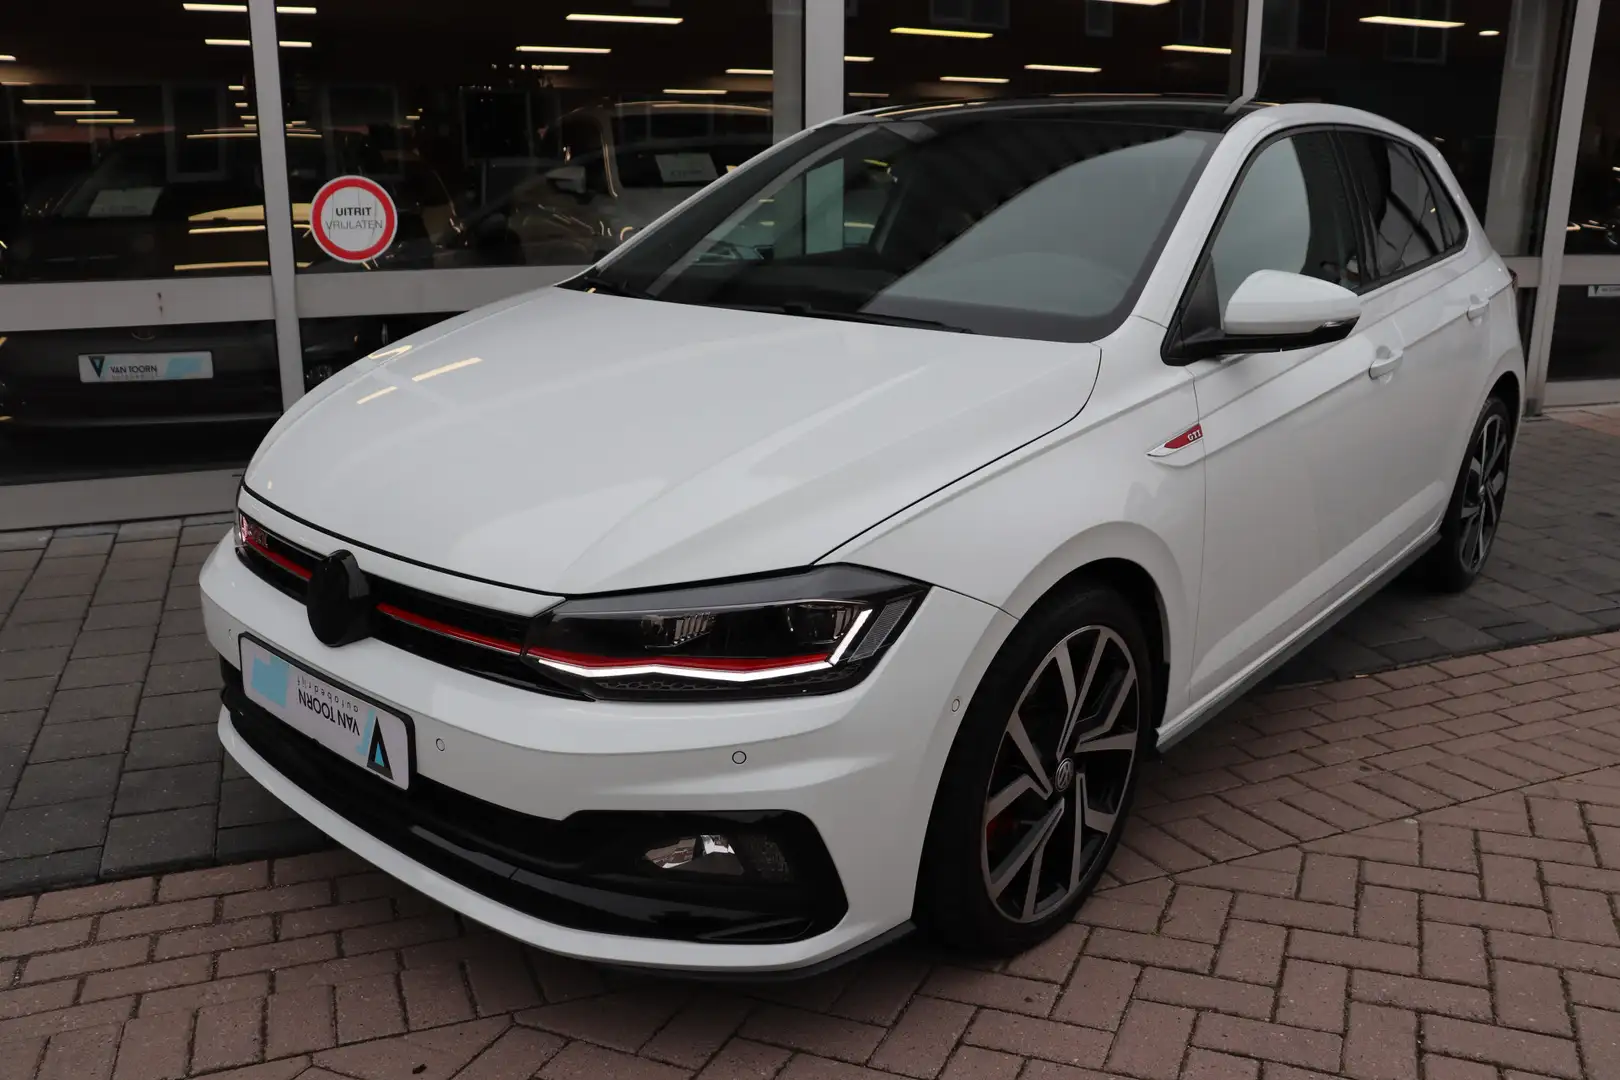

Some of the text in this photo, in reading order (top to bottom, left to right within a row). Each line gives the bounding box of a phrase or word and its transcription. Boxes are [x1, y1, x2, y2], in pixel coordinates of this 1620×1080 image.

[335, 206, 372, 217] UITRIT
[325, 219, 383, 230] VRIJLATEN
[110, 364, 158, 374] VAN TOORN
[1187, 429, 1202, 441] GTI
[297, 676, 359, 713] autobedrijf
[298, 689, 360, 736] VAN TOORN
